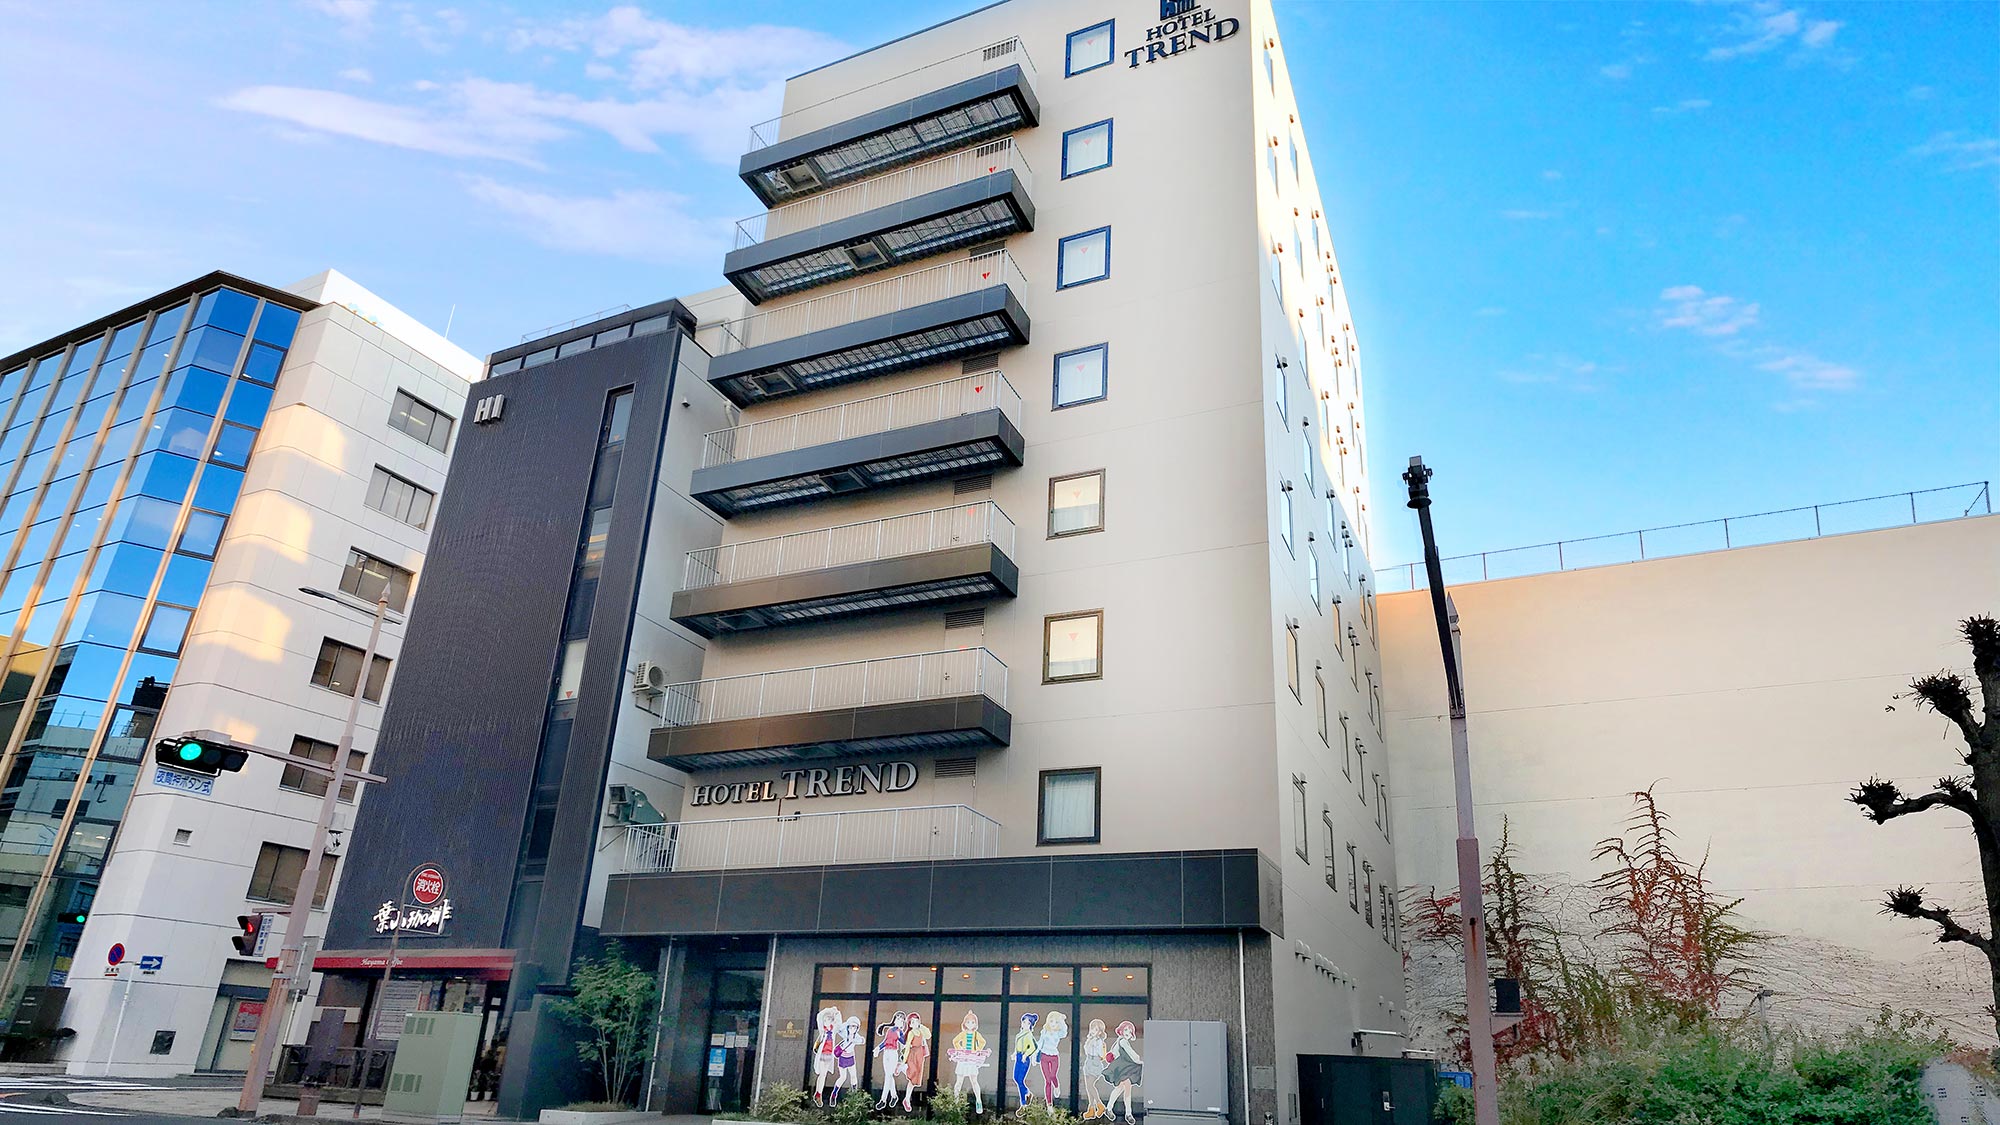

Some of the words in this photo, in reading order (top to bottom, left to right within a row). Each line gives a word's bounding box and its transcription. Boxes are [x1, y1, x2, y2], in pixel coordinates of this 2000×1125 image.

[1124, 17, 1240, 69] TREND
[1146, 8, 1216, 42] HOTEL
[691, 781, 777, 806] HOTEL
[781, 760, 919, 799] TREND
[416, 878, 441, 895] 消火栓
